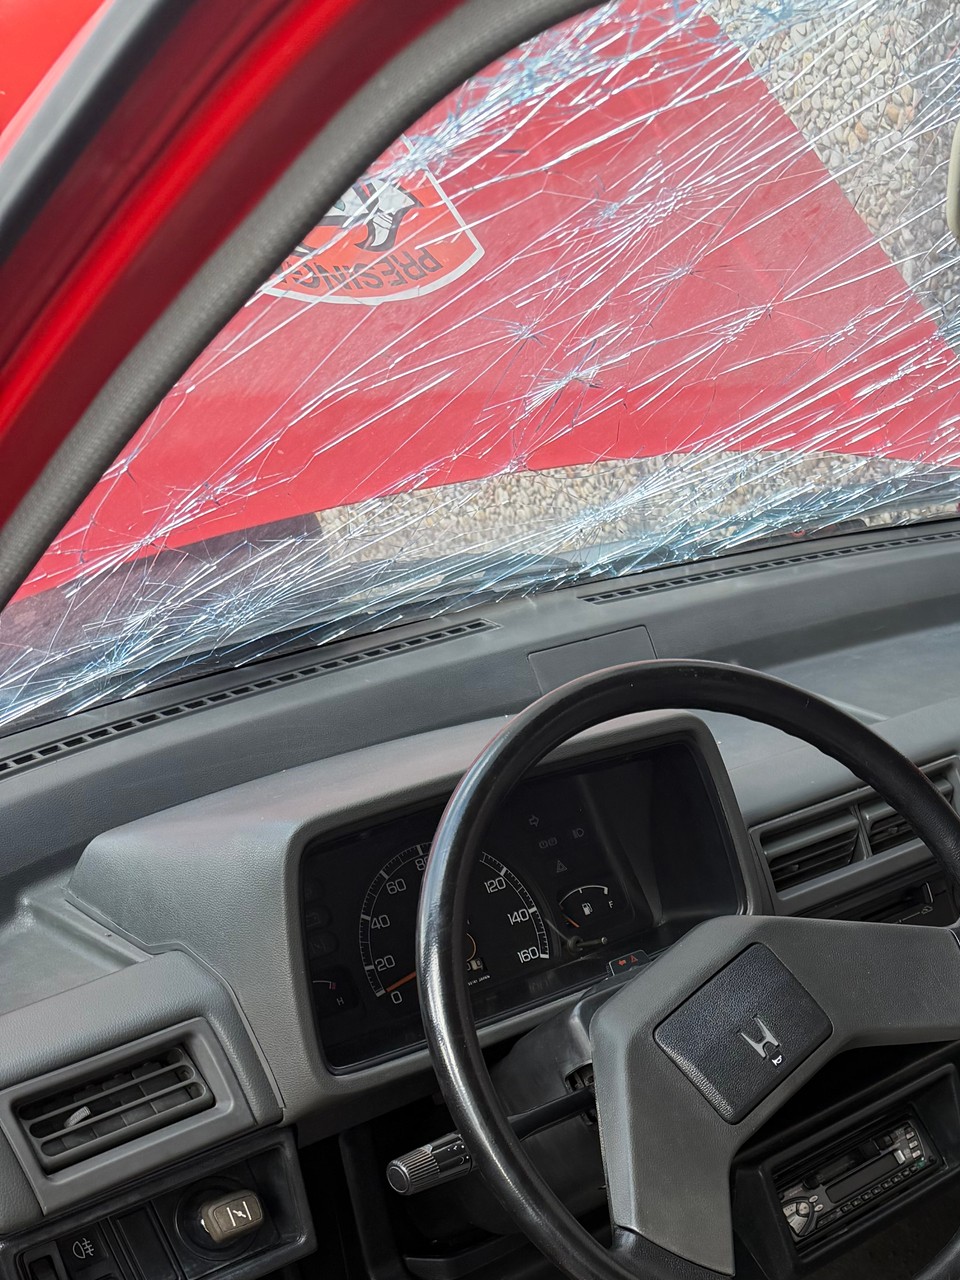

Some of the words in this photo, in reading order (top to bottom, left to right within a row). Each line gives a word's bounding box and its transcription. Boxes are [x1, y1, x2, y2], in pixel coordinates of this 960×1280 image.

[386, 878, 407, 895] 60
[484, 877, 506, 894] 120
[371, 914, 390, 930] 40
[507, 908, 530, 926] 140
[517, 946, 539, 963] 160
[375, 955, 396, 972] 20
[390, 990, 403, 1004] 0
